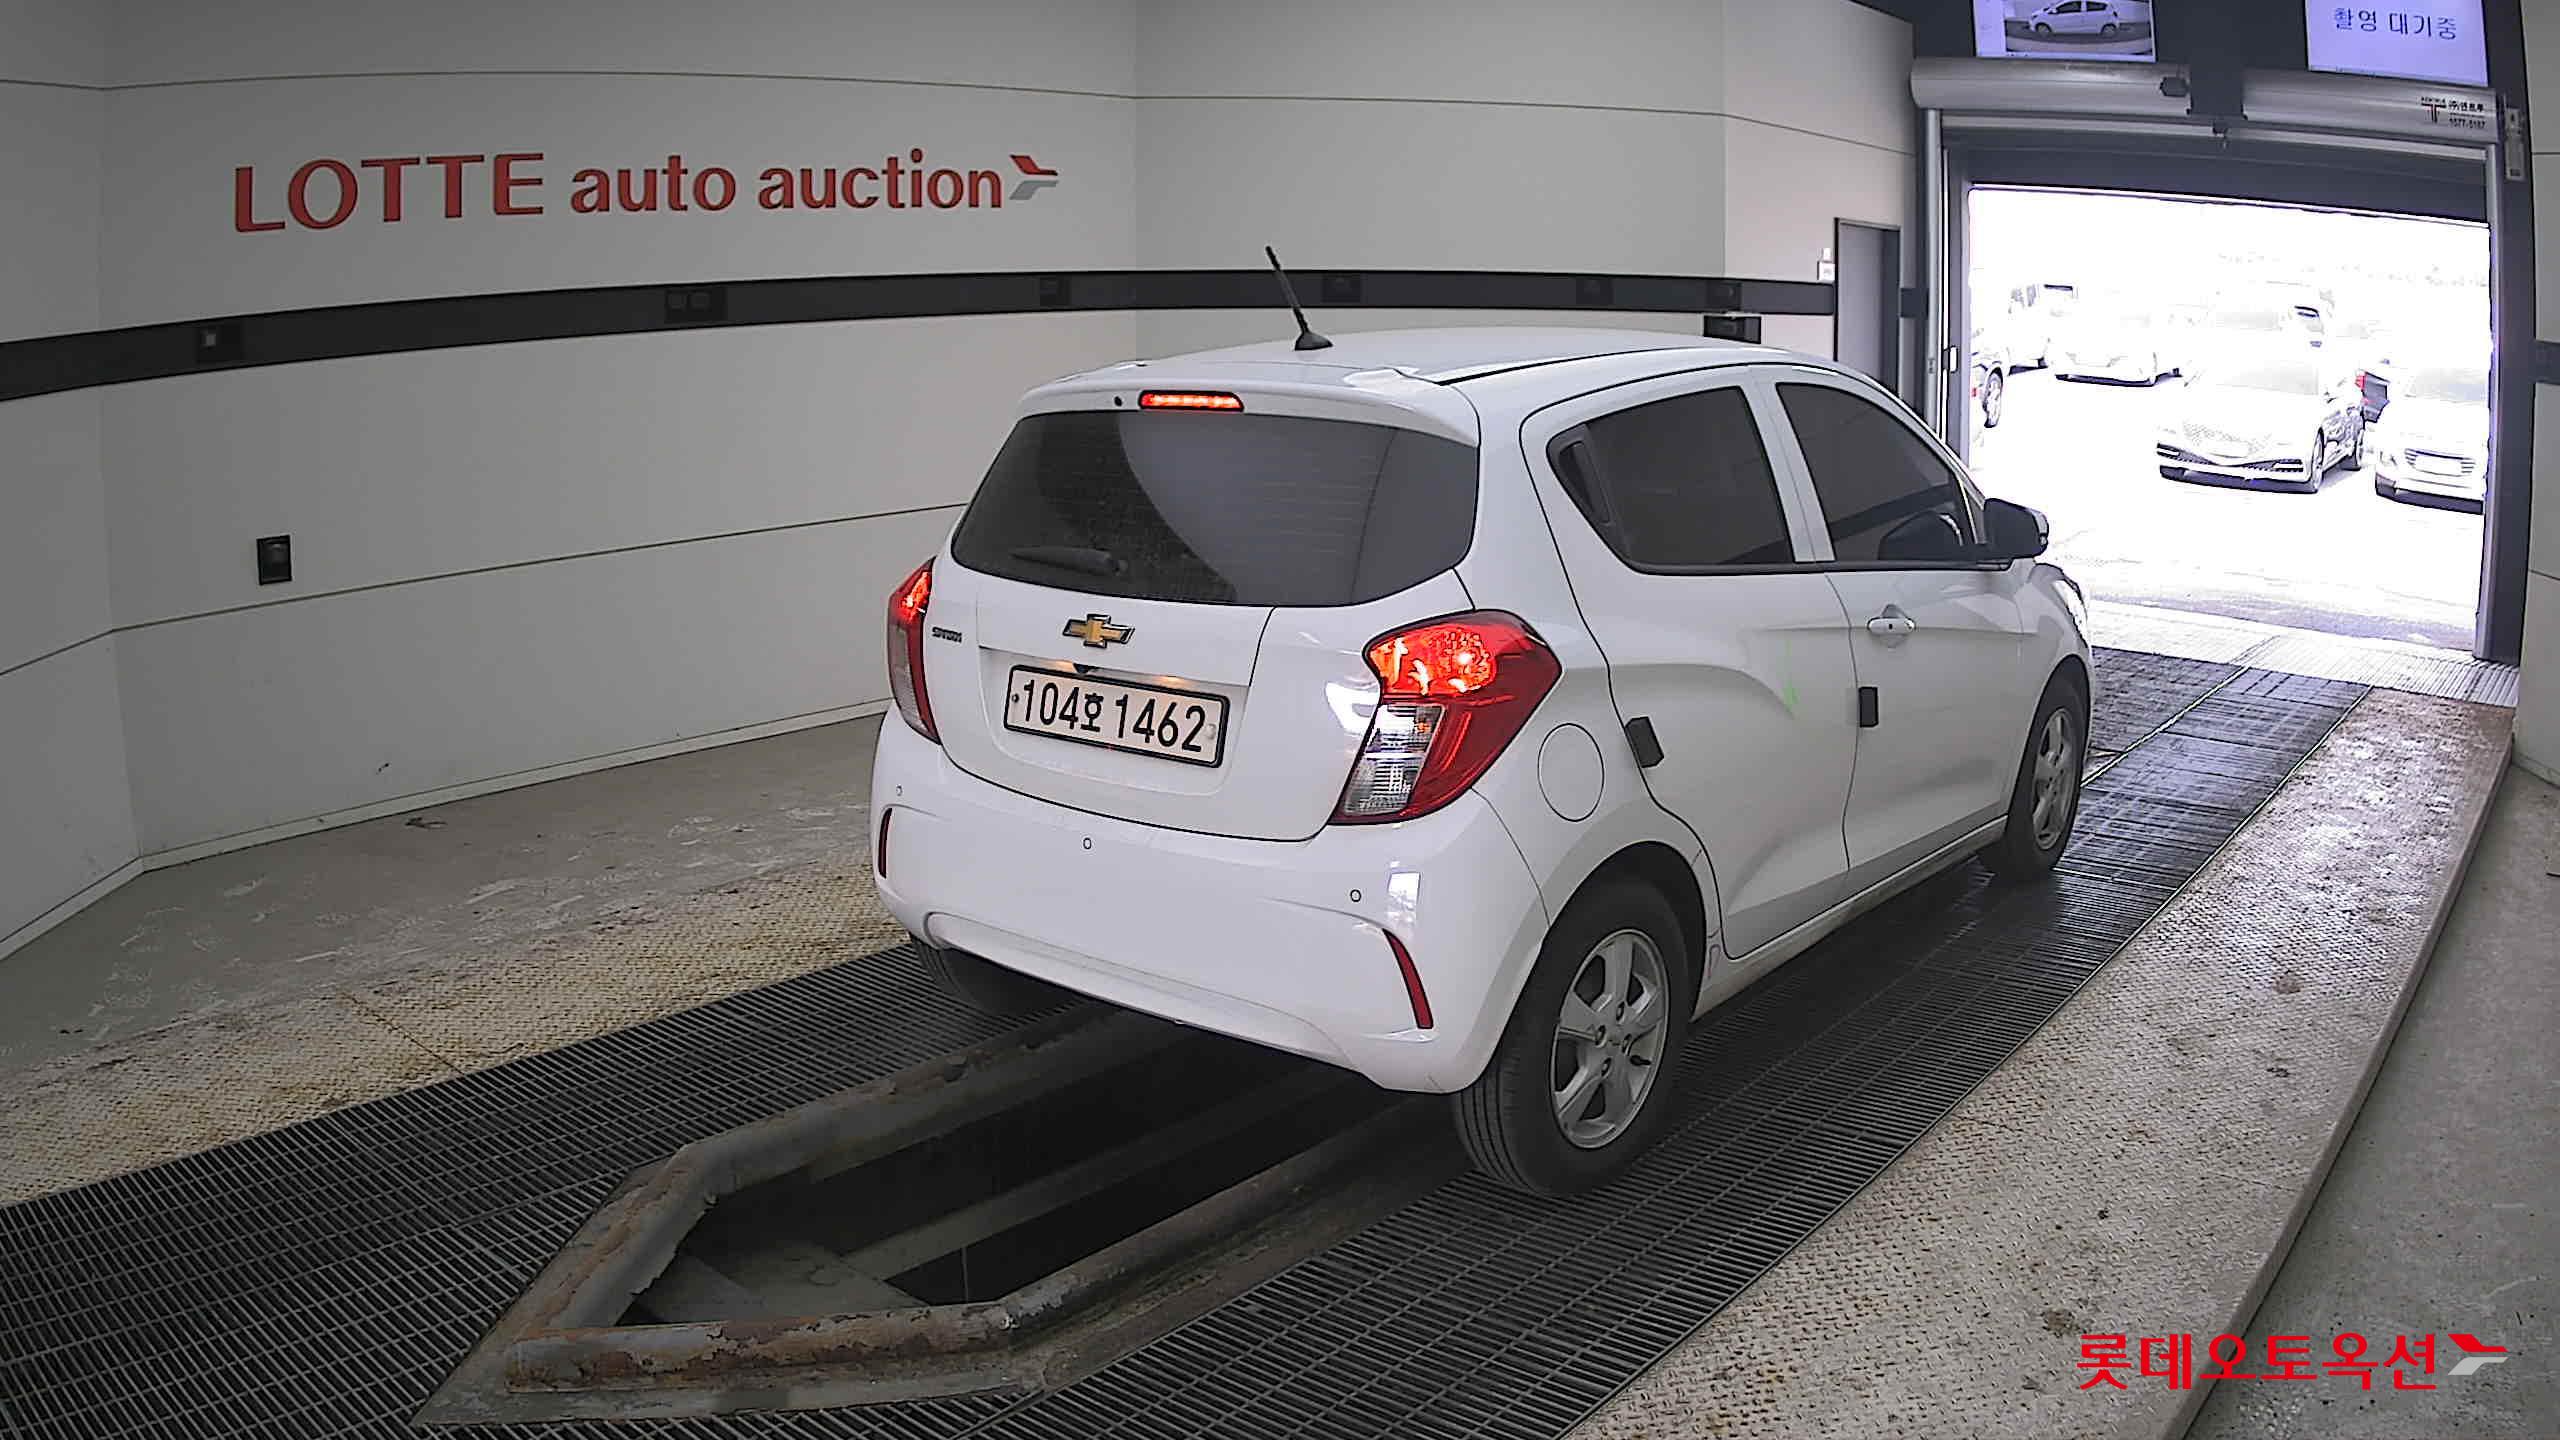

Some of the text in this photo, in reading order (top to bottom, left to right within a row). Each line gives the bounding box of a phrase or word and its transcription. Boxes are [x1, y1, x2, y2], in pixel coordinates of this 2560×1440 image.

[2335, 8, 2457, 40] 촬영 대기중
[236, 151, 1004, 232] LOTTE auto auction
[1023, 679, 1206, 752] 104호 1462
